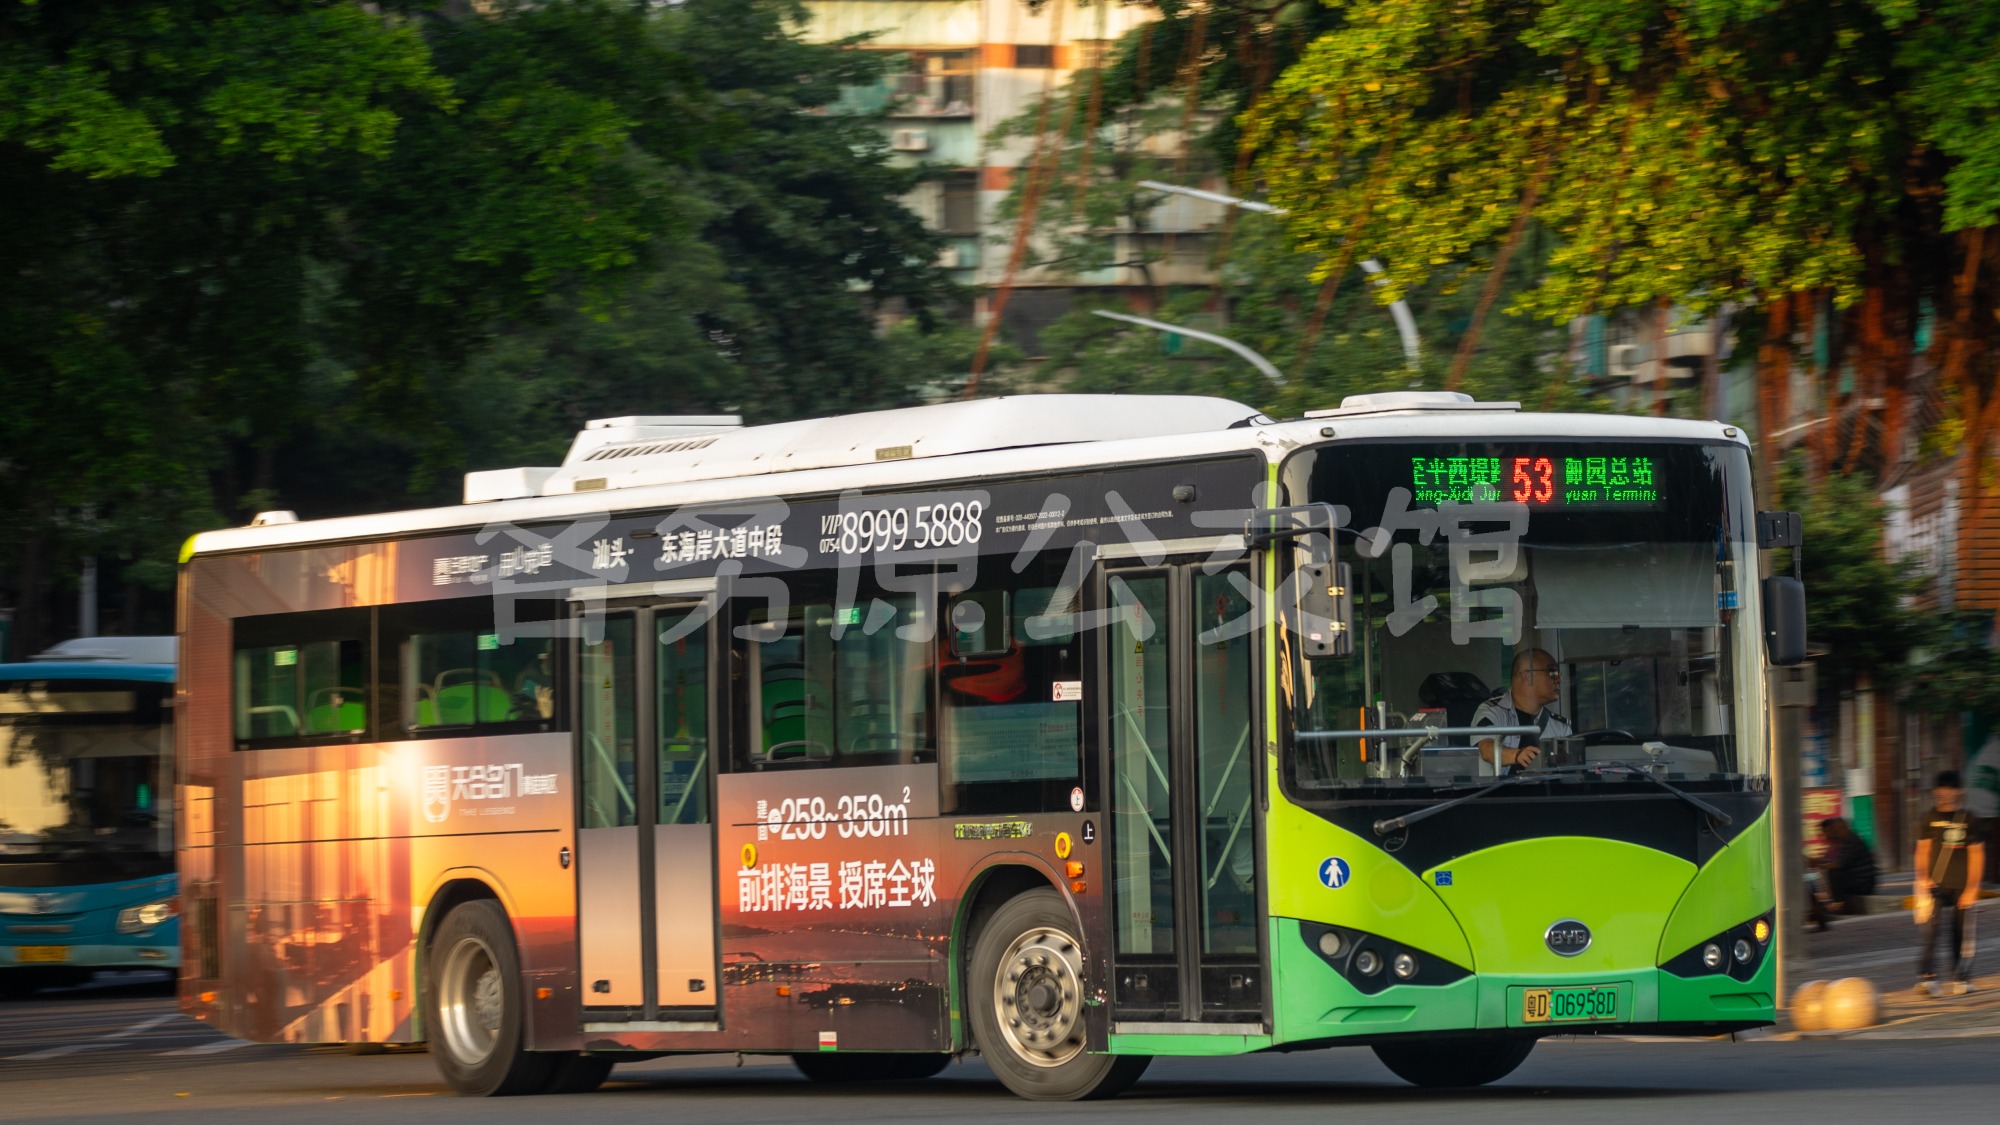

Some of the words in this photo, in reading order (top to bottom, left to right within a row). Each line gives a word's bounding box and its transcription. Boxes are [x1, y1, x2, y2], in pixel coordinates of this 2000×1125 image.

[1513, 457, 1553, 503] 53
[820, 514, 843, 536] VIP
[840, 507, 909, 555] 8999
[914, 499, 983, 547] 5888
[661, 524, 783, 565] 东海岸大道中段
[819, 537, 841, 555] 0754
[1084, 823, 1094, 840] 上
[737, 863, 833, 913] 前排海景
[838, 858, 937, 910] 授席全球
[1551, 929, 1587, 946] BYD
